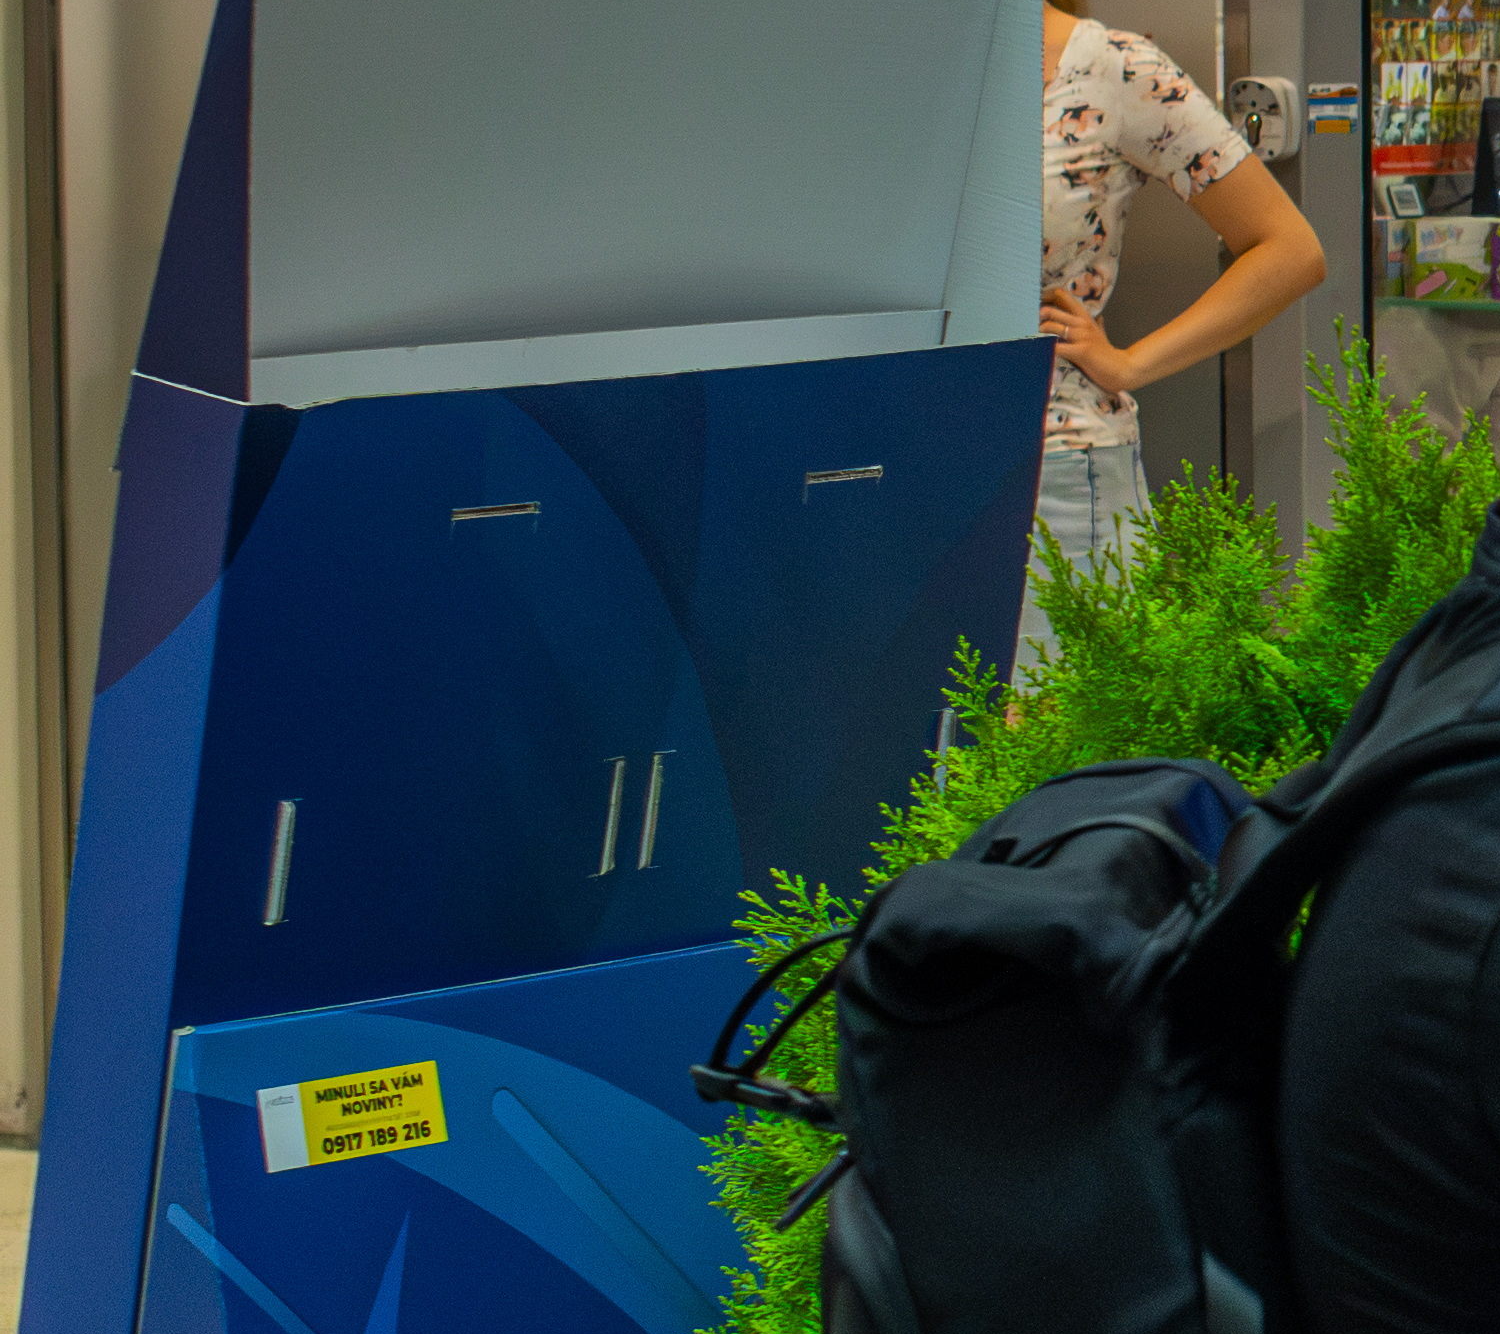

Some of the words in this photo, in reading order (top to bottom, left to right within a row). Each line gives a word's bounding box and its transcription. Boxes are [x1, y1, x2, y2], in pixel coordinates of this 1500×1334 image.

[314, 1083, 366, 1104] MINULI
[369, 1079, 388, 1094] SA
[391, 1072, 423, 1091] VÁM
[341, 1094, 403, 1117] NOVINY?
[322, 1131, 363, 1155] 0917
[368, 1127, 398, 1147] 189
[402, 1119, 431, 1142] 216
